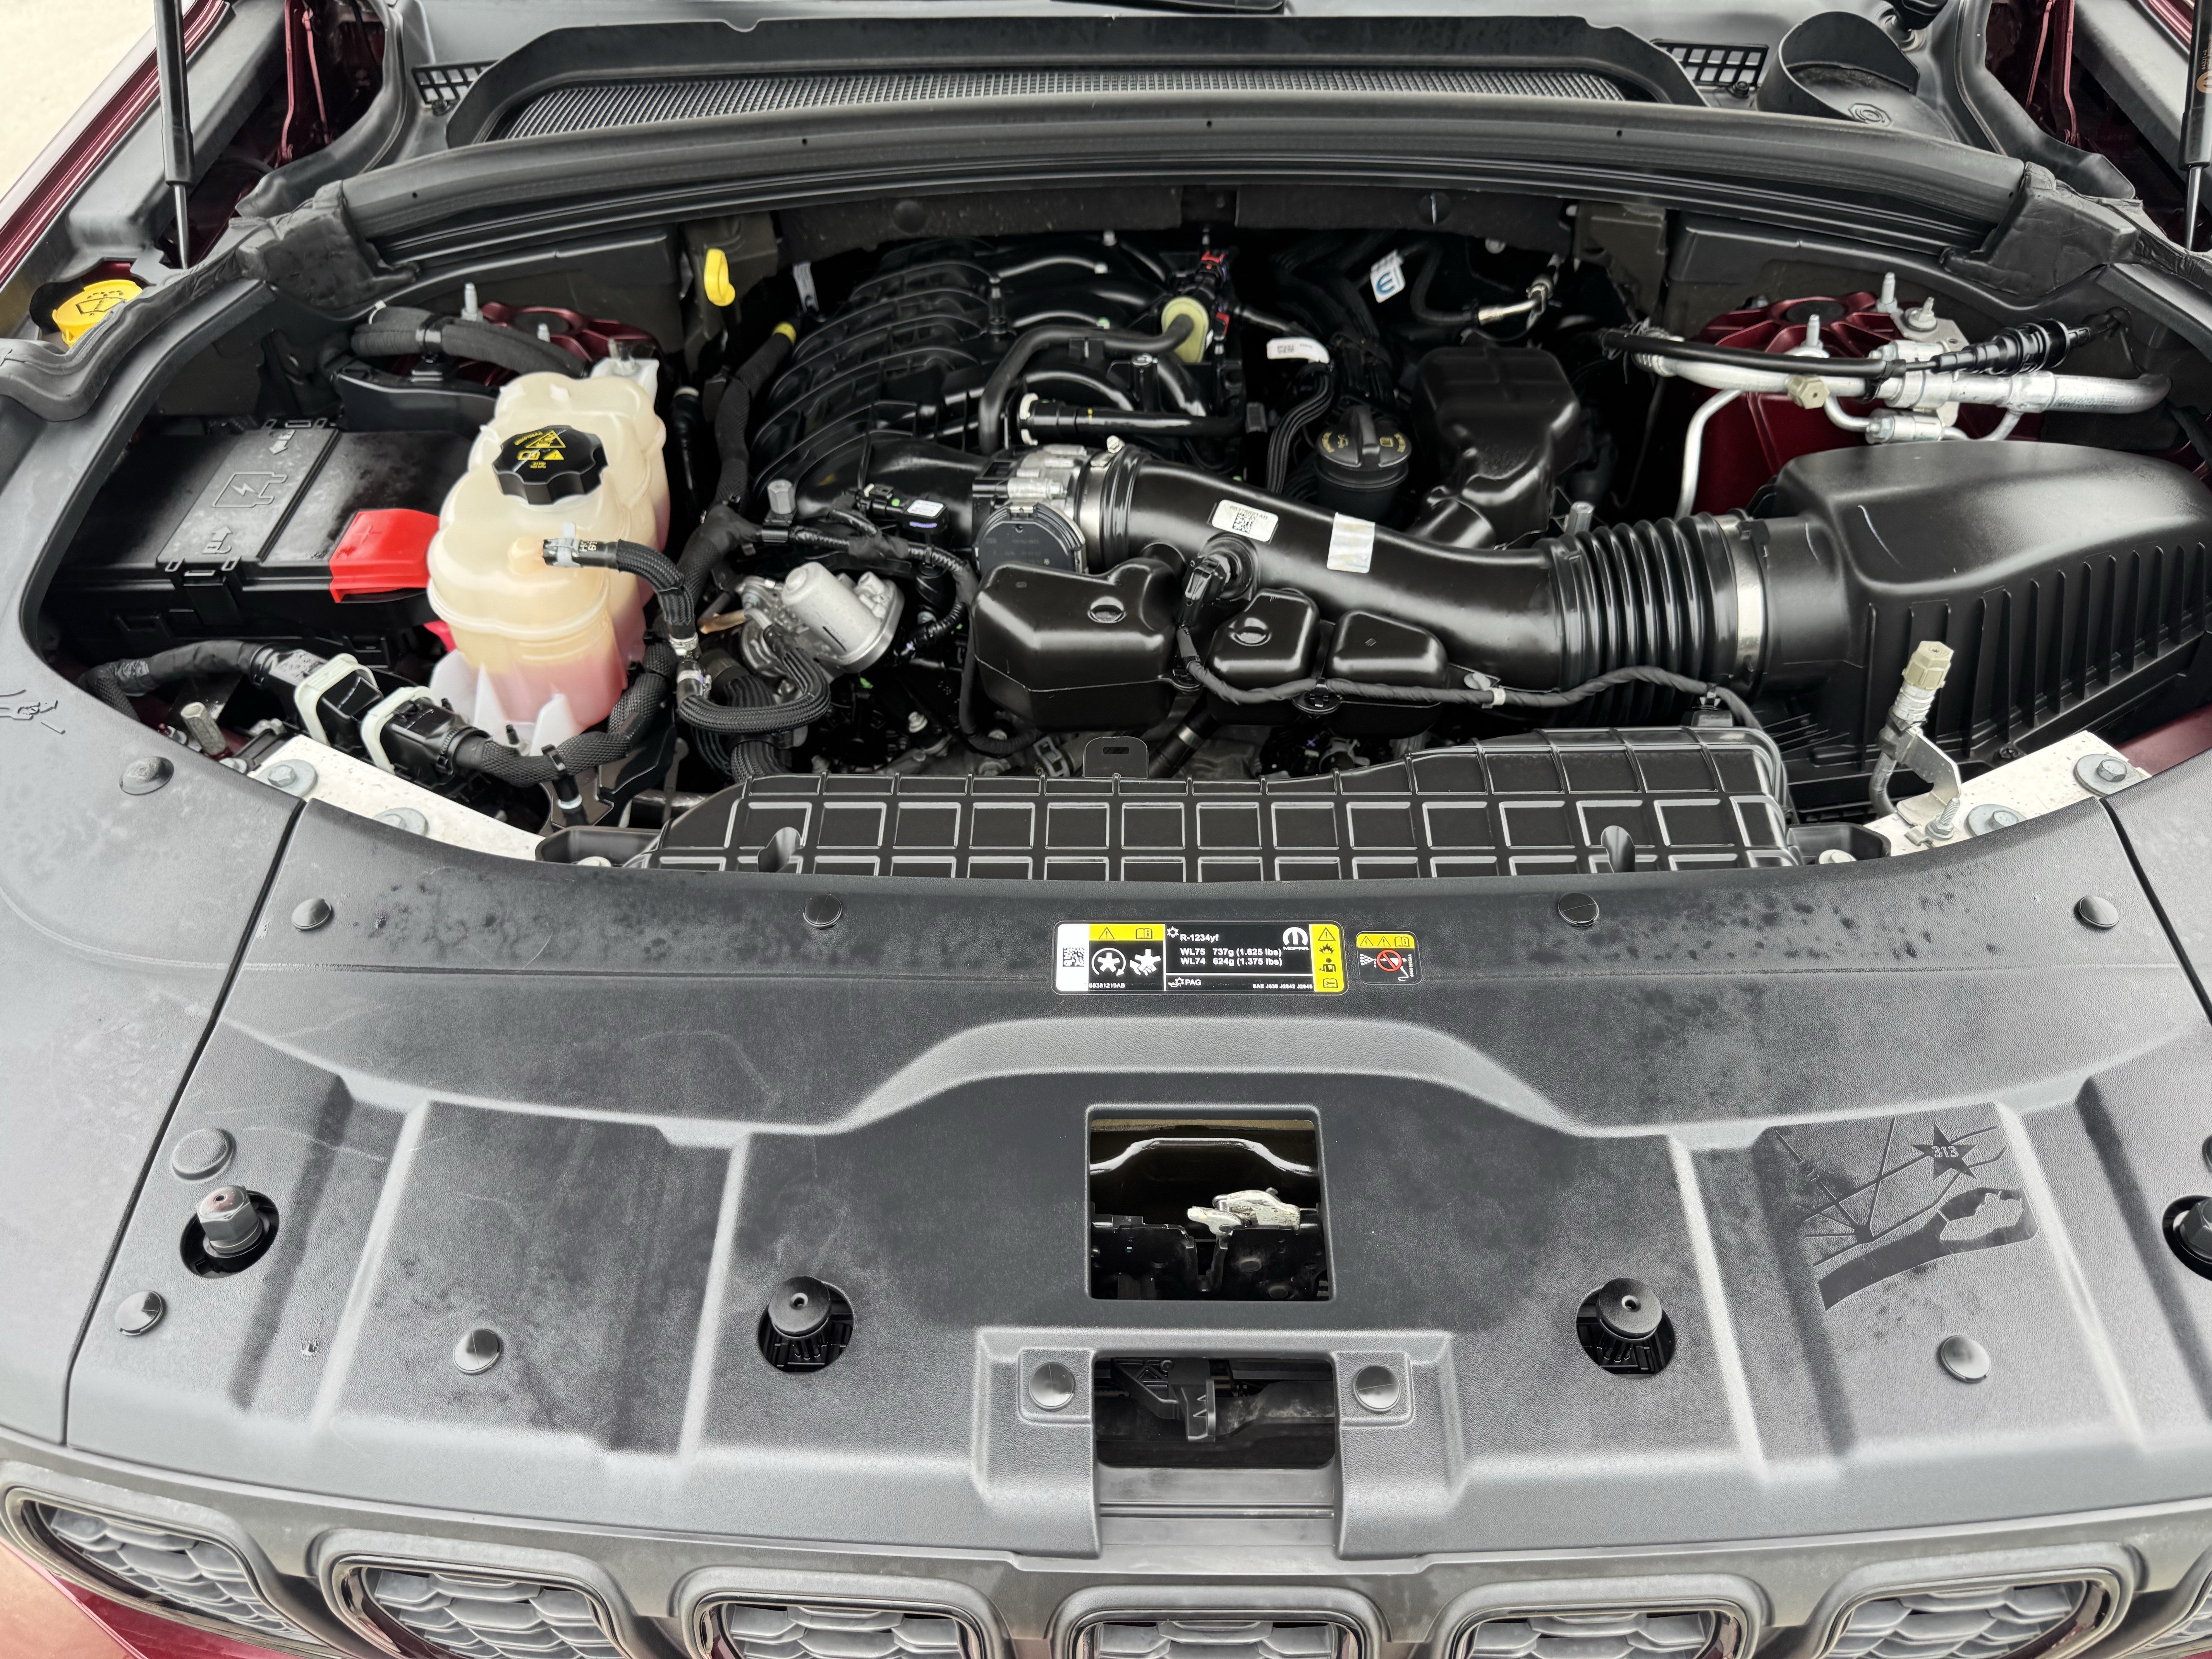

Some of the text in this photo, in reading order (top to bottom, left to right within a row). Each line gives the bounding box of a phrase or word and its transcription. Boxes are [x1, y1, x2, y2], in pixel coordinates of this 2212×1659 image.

[1180, 934, 1219, 943] R-1234yf
[1212, 948, 1234, 957] 737g
[1236, 948, 1263, 957] (1.625
[1265, 948, 1282, 958] lbs)
[1212, 957, 1235, 967] 624g
[1237, 957, 1264, 967] (1.375
[1265, 957, 1283, 967] lbs)
[1931, 1146, 1959, 1158] 313
